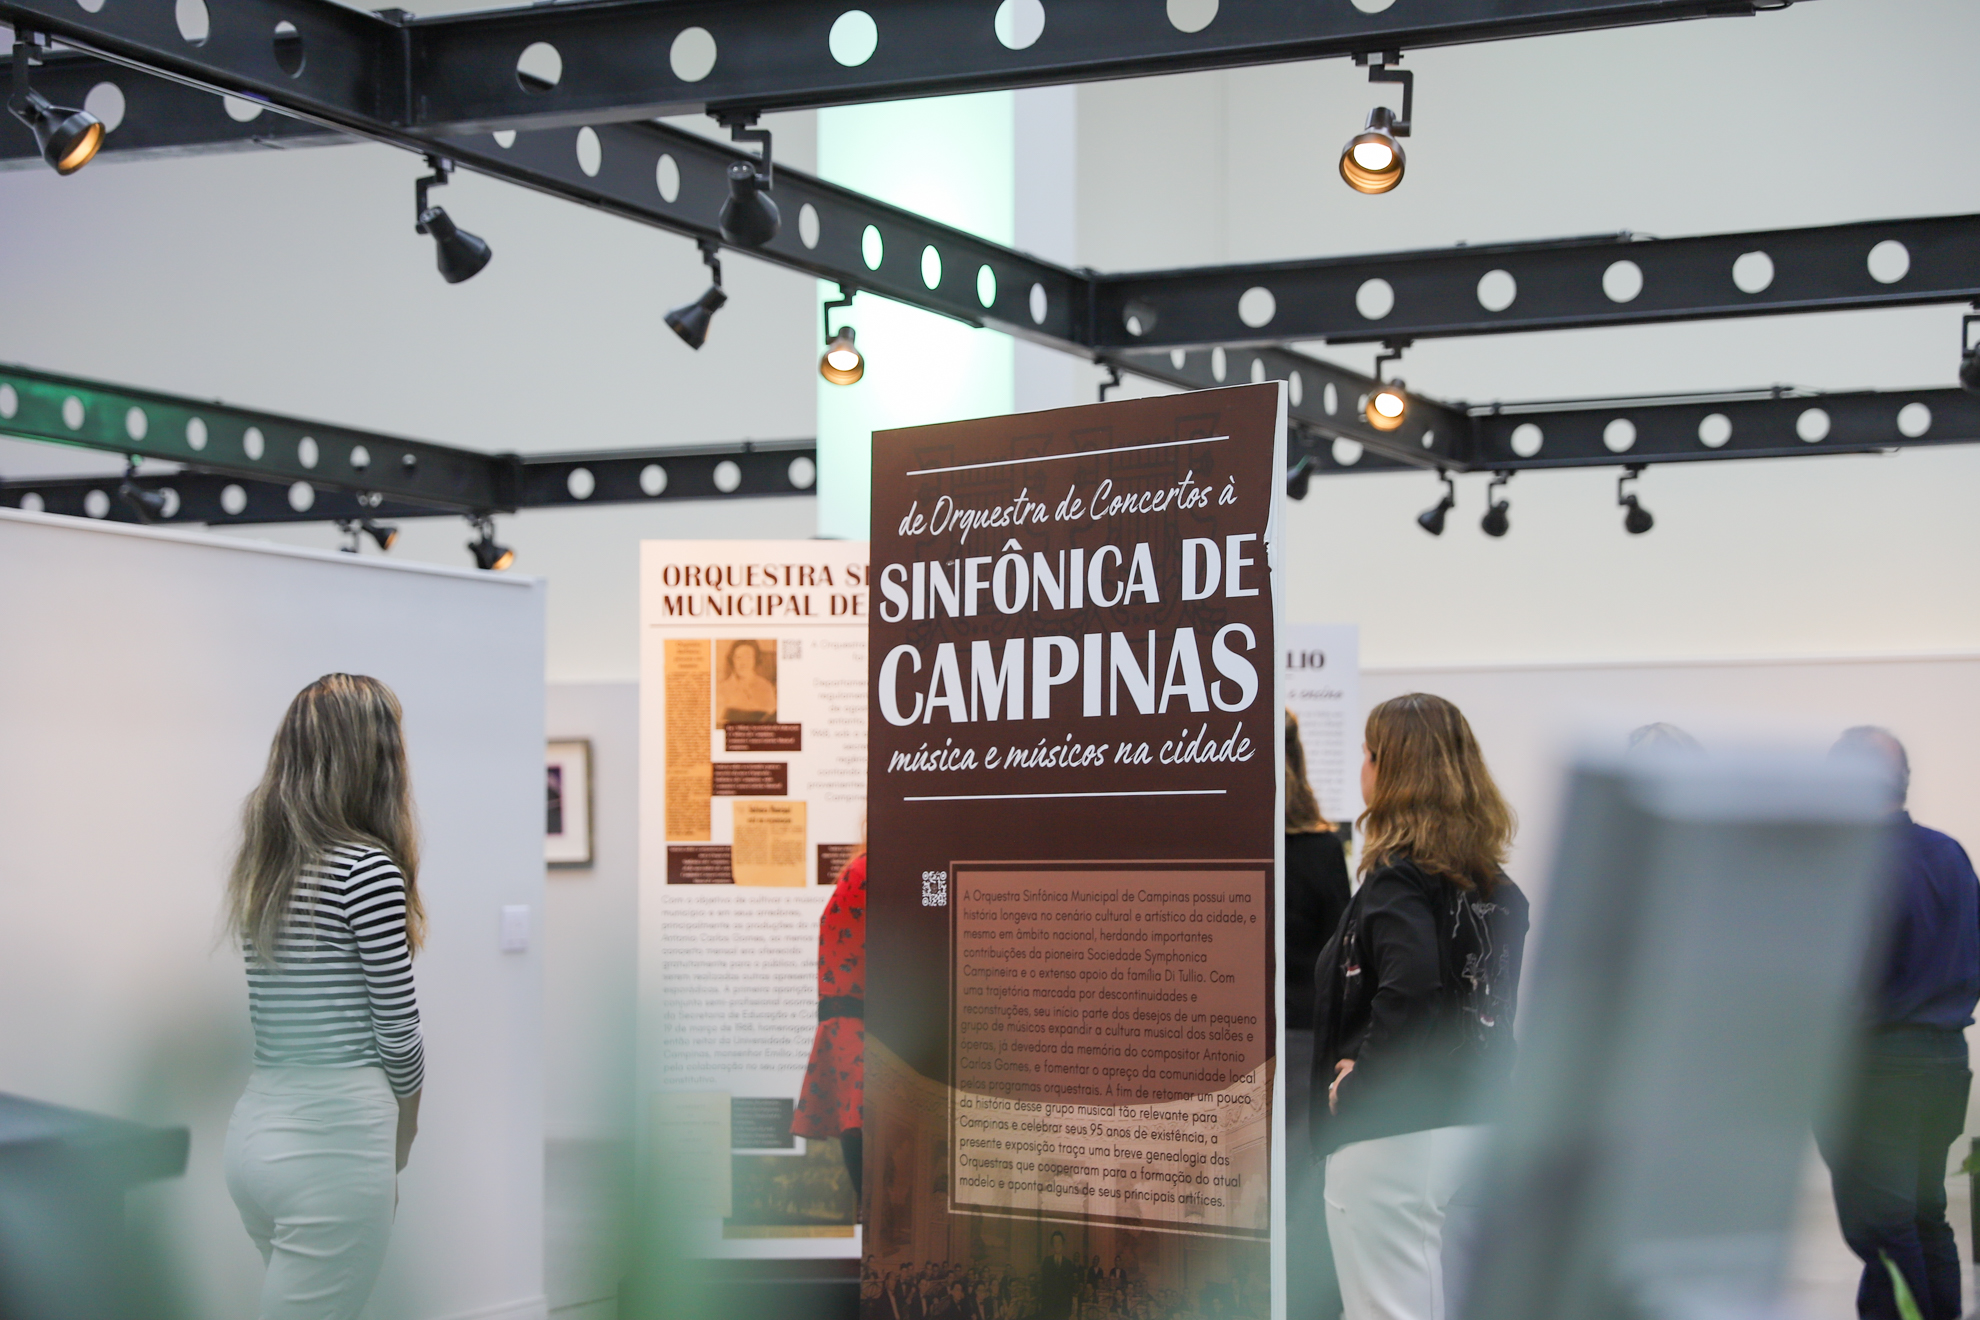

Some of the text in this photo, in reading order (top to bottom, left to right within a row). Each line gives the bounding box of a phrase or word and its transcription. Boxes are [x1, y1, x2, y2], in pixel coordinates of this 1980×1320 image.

[898, 470, 1238, 545] de Orquestra de Concertos à
[662, 563, 834, 591] ORQUESTRA
[879, 533, 1260, 624] SINFÔNICA DE
[663, 593, 866, 617] MUNICIPAL DE
[877, 623, 1260, 727] CAMPINAS
[887, 721, 1256, 773] música e músicos na cidade
[963, 889, 1252, 906] A Orquestra Sinfônica Municipal de Campinas possui uma
[963, 908, 1256, 925] história longeva no cenário cultural e artístico da cidade, e
[963, 927, 1213, 945] mesmo em âmbito nacional, herdando importantes
[963, 945, 1207, 965] contribuições da pioneira Sociedade Symphonica
[963, 964, 1235, 983] Campineira e o extenso apoio da família Di Tullio. Com
[963, 985, 1197, 1002] uma trajetória marcada por descontinuidades e
[963, 1004, 1257, 1027] reconstruções, seu início parte dos desejos de um pequeno
[961, 1019, 1254, 1042] grupo de músicos expandir a cultura musical dos salões e
[1011, 1040, 1057, 1054] devedora
[1060, 1041, 1074, 1055] da
[1077, 1043, 1121, 1056] memória
[1124, 1044, 1138, 1058] do
[1141, 1049, 1200, 1063] compositor
[1203, 1049, 1245, 1062] Antonio
[960, 1057, 1256, 1084] Carlos Gomes, e fomentar o apreço da comunidade local
[989, 1080, 1042, 1094] programas
[1044, 1083, 1102, 1098] orquestrais.
[1105, 1084, 1113, 1096] A
[1116, 1084, 1132, 1098] fim
[1135, 1084, 1149, 1099] de
[1152, 1088, 1194, 1101] retomar
[1197, 1092, 1213, 1102] um
[1217, 1093, 1251, 1106] pouco
[960, 1095, 1218, 1126] da história desse grupo musical tão relevante para
[959, 1115, 1218, 1146] Campinas e celebrar seus 95 anos de existência, a
[960, 1137, 1230, 1167] presente exposição traça uma breve genealogia das
[959, 1154, 1241, 1187] Orquestras que cooperaram para a formação do atual
[959, 1175, 1225, 1208] modelo e aponta alguns de seus principais artífices.
